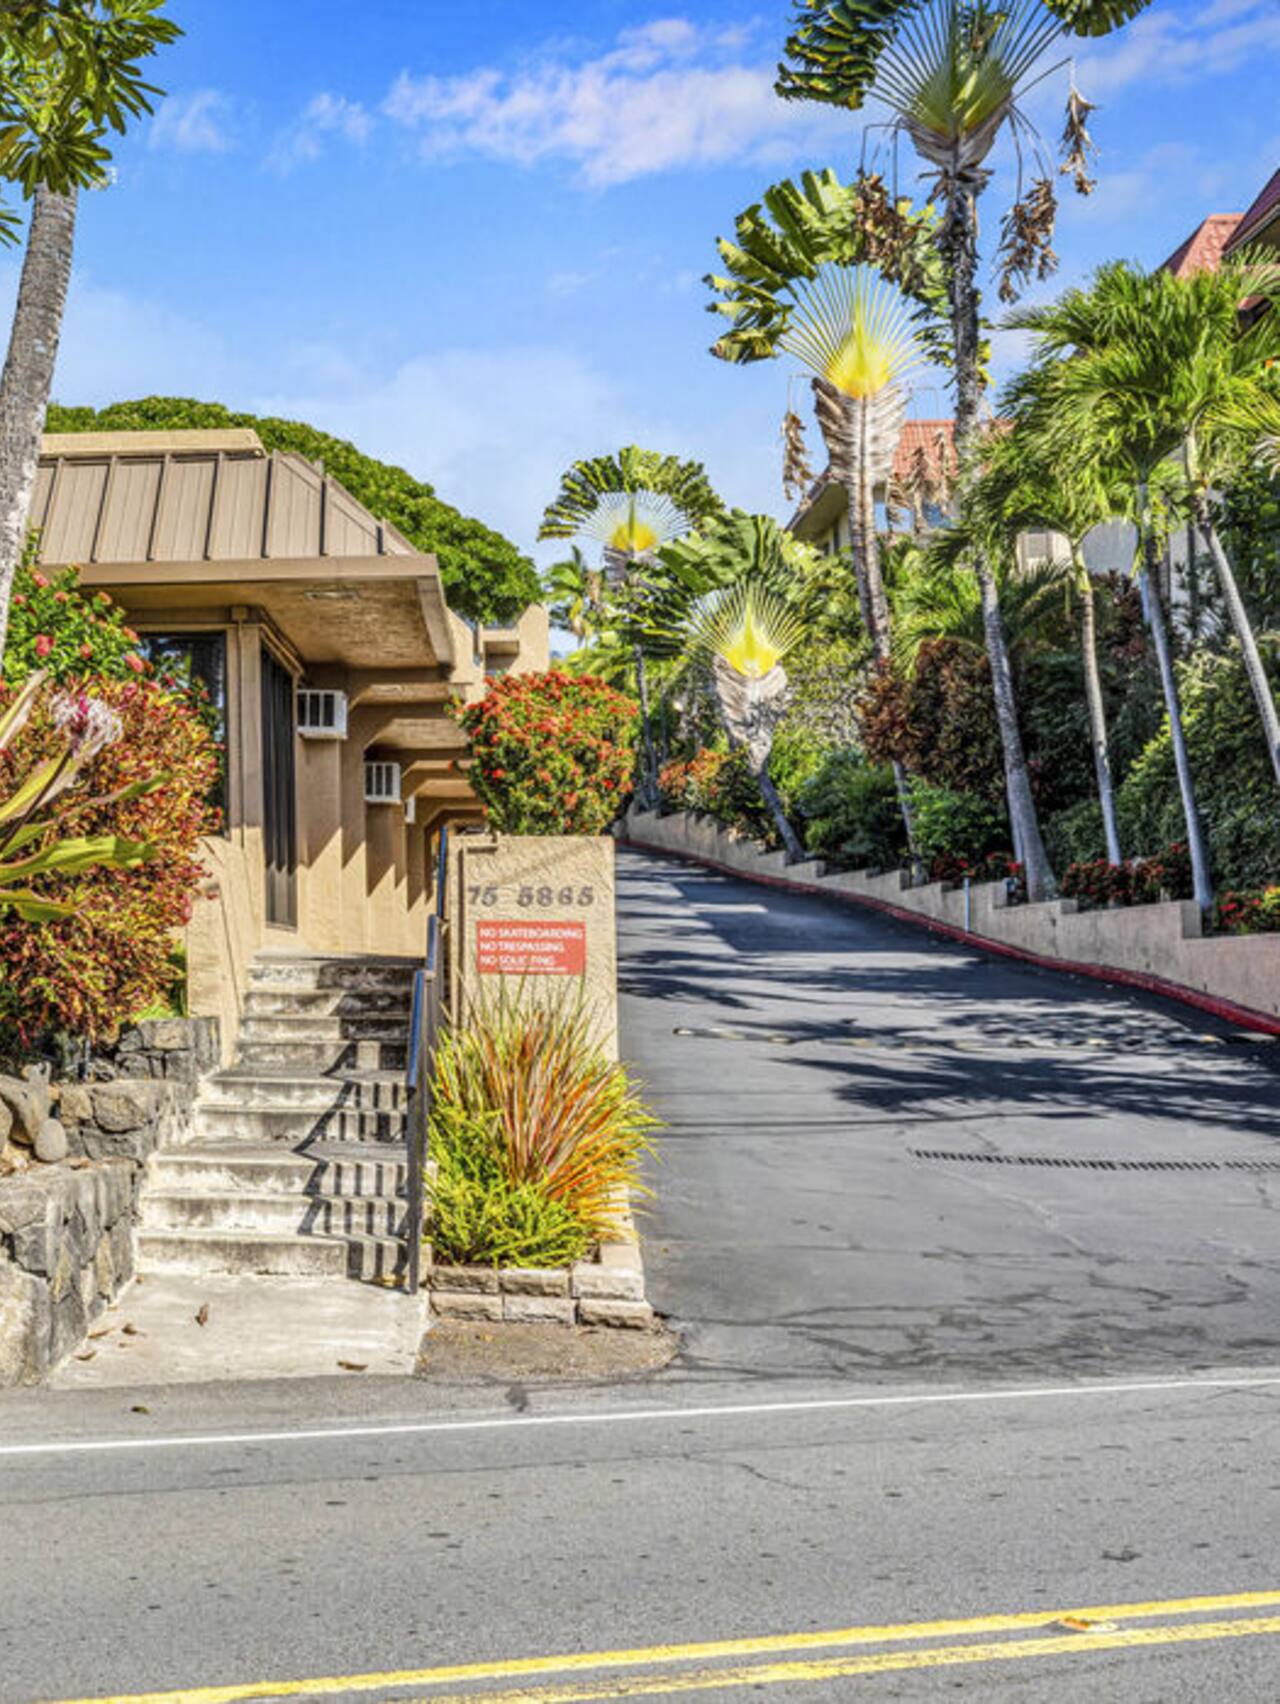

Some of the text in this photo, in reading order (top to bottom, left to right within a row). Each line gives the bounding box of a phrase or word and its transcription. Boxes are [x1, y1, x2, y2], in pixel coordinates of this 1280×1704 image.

[468, 885, 594, 907] 75 5865
[480, 928, 583, 940] NO SKATEBOARDING
[480, 942, 564, 952] NO TRESPASSING
[480, 955, 555, 966] NO SOLICTING
